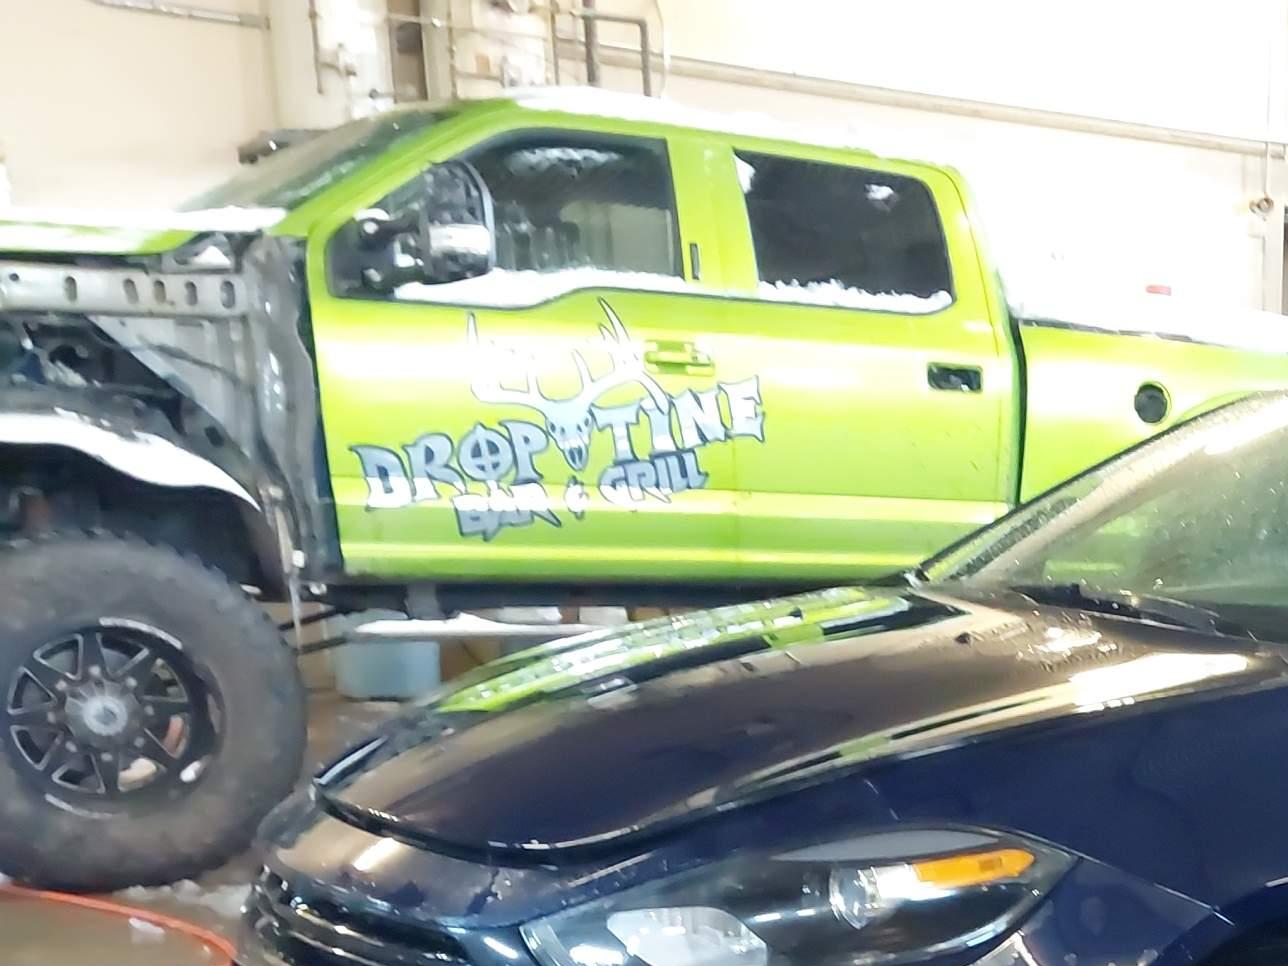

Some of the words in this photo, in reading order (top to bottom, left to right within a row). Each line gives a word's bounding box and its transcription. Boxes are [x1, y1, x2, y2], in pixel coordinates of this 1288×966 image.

[349, 420, 549, 511] DROP
[592, 375, 765, 462] TINE
[600, 451, 708, 504] GRILL
